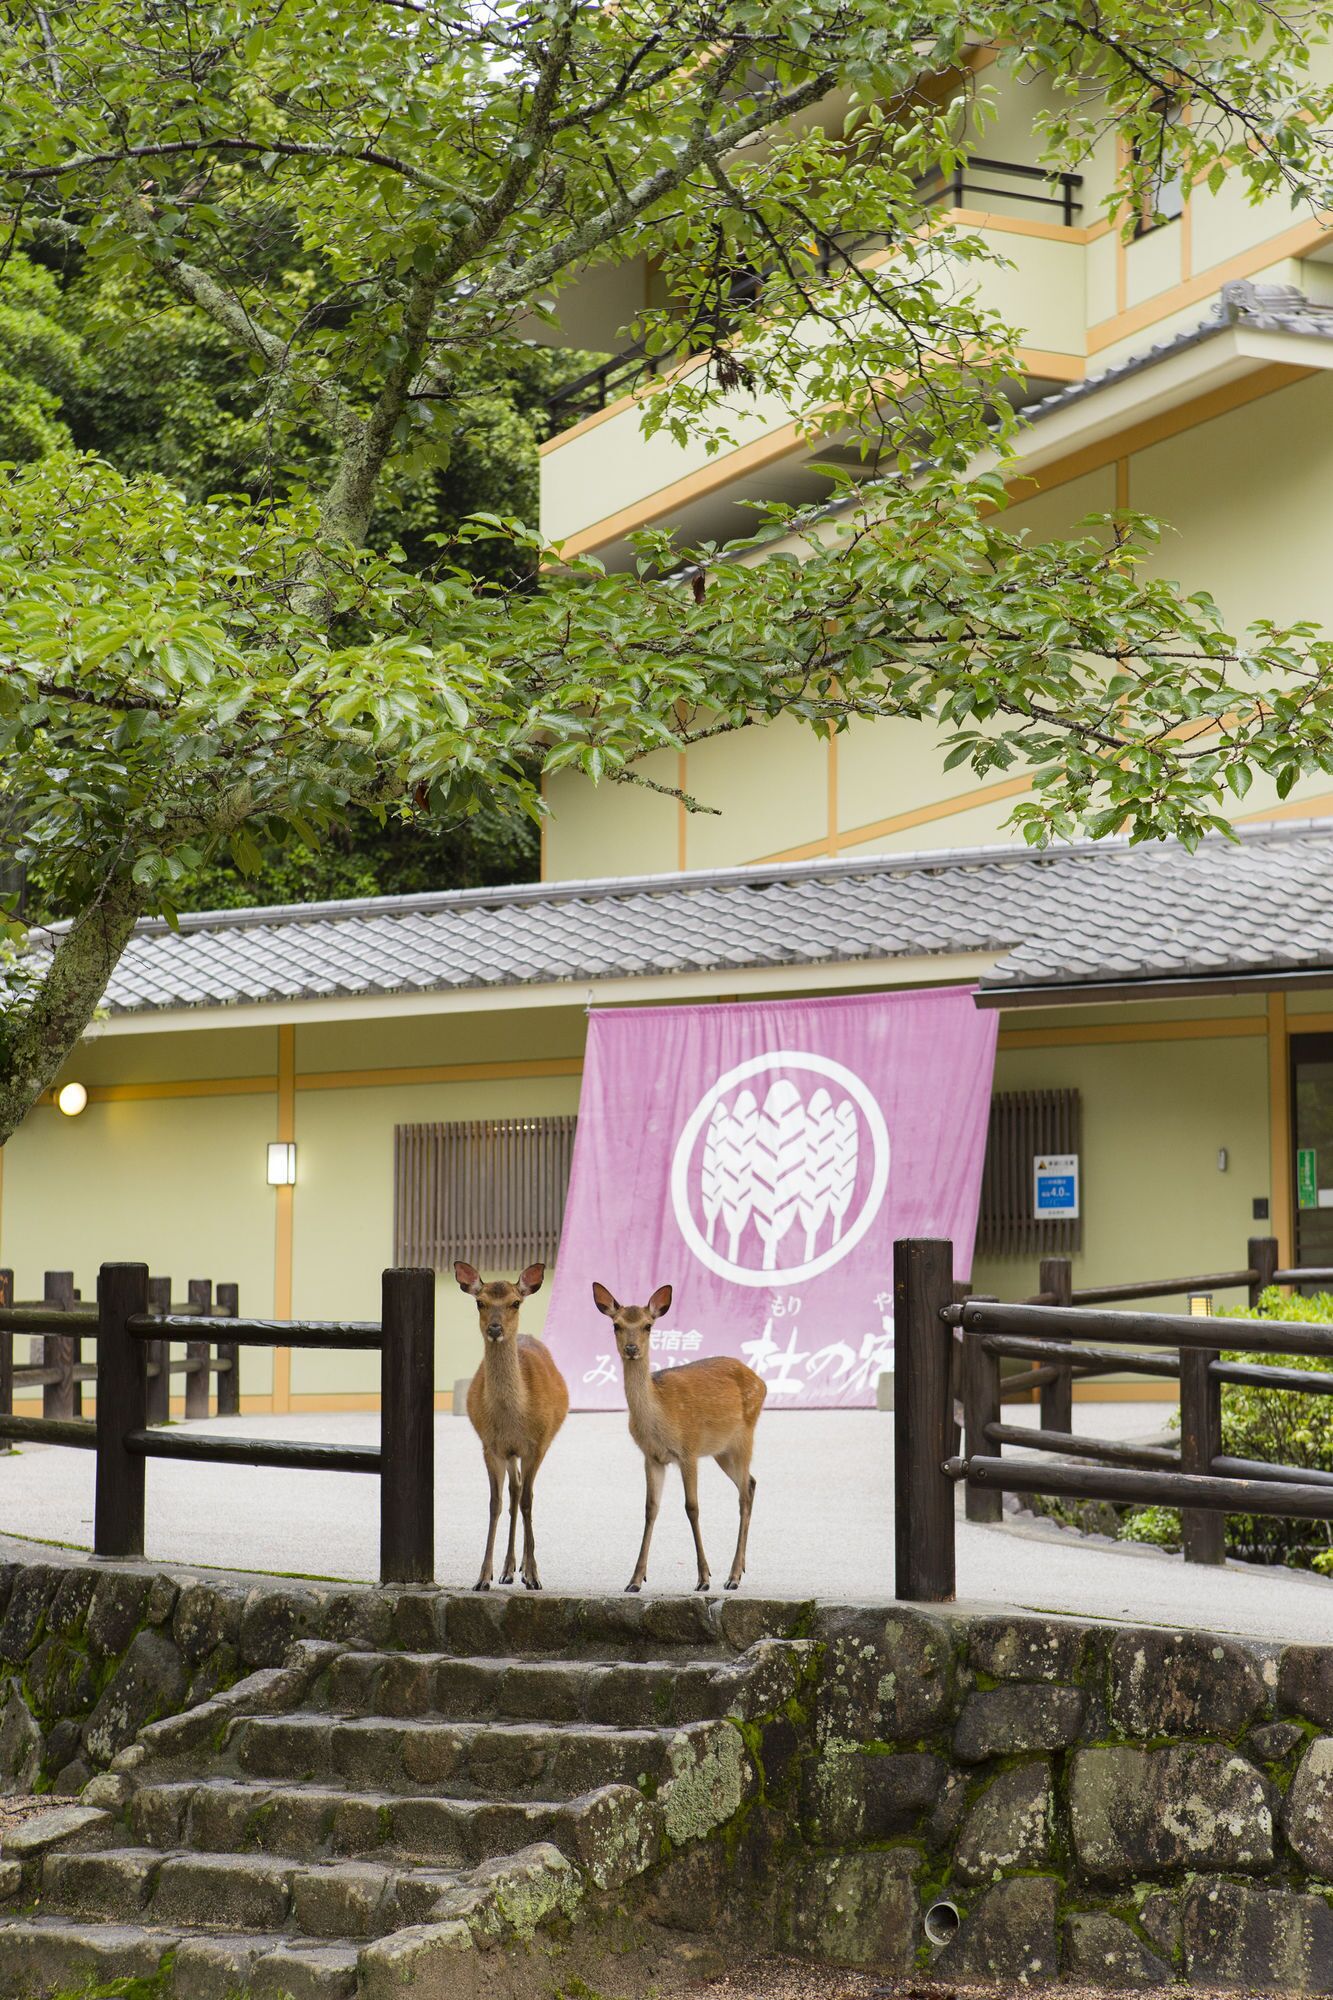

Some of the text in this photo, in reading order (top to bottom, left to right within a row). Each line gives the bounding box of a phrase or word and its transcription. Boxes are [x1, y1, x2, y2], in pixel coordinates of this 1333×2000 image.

[771, 1295, 802, 1317] もり
[873, 1291, 895, 1312] や
[648, 1329, 704, 1351] 民宿舎
